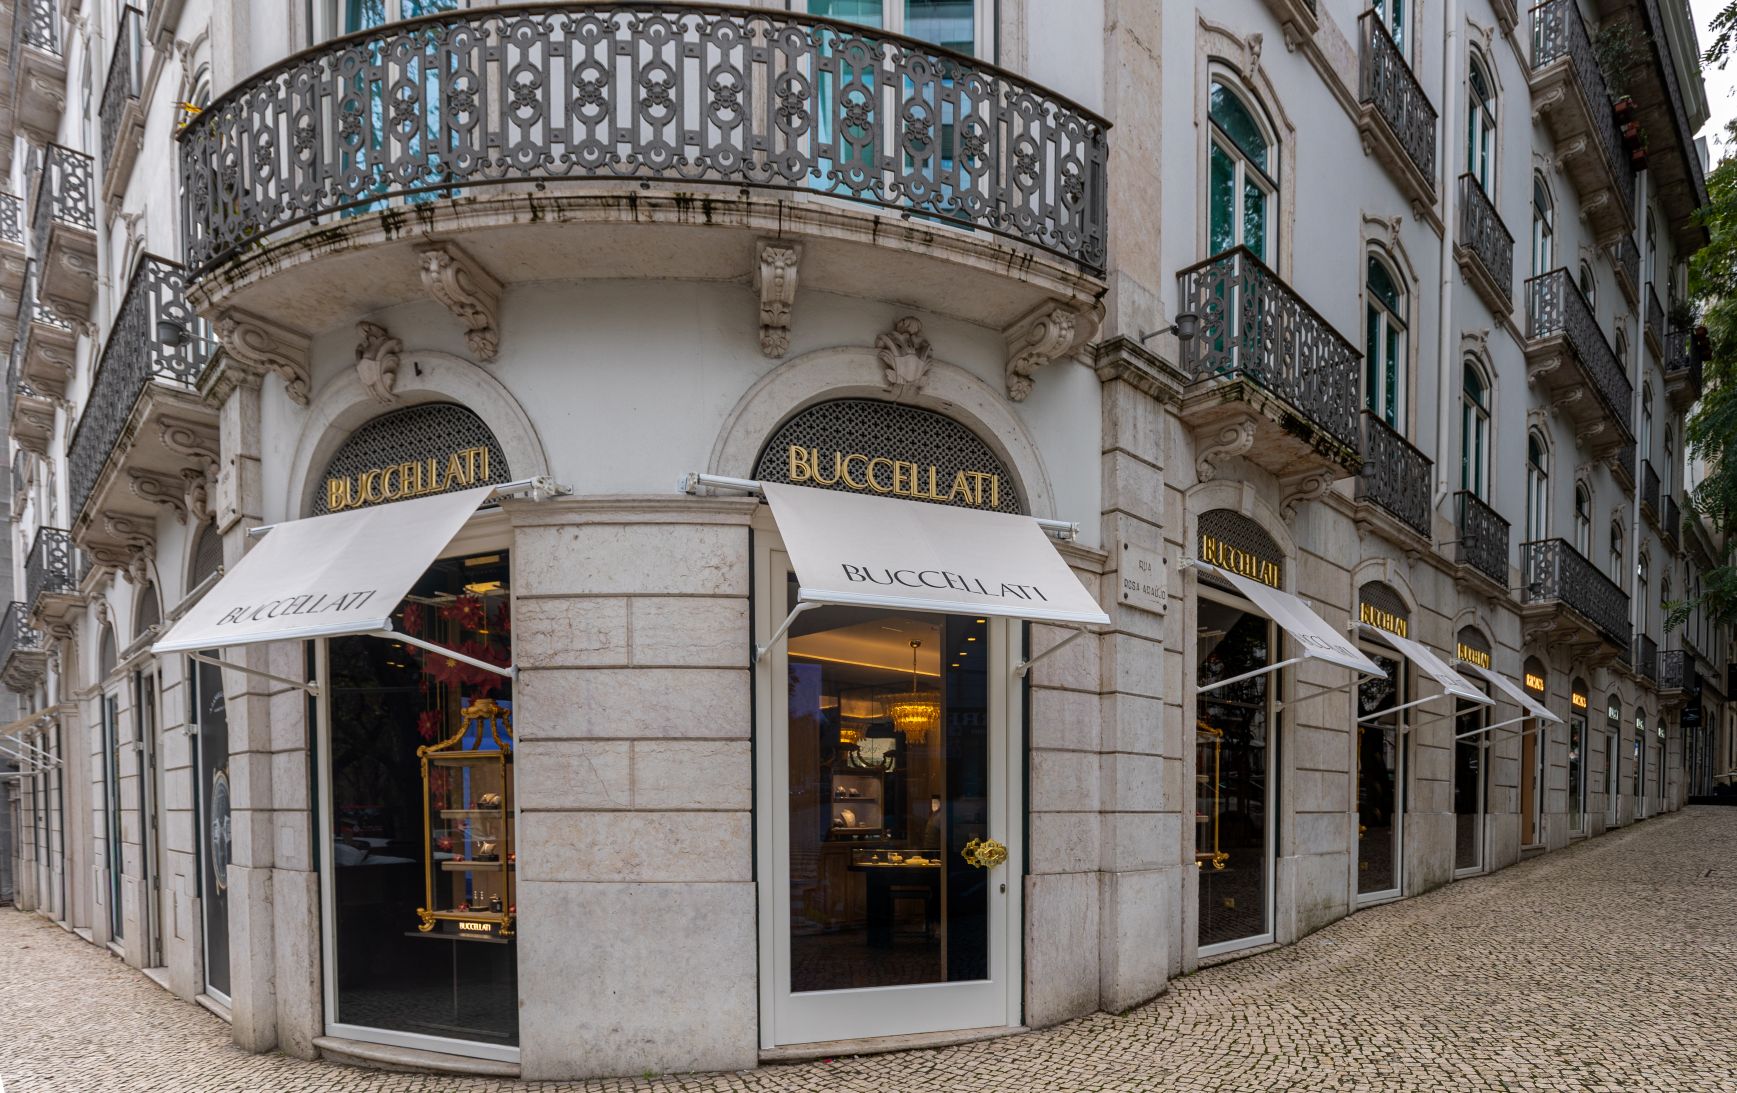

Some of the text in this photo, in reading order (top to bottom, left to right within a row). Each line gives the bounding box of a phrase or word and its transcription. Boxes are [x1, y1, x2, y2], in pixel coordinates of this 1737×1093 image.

[328, 446, 489, 511] BUCCELLATI
[788, 445, 1000, 507] BUCCELLATI
[841, 563, 1048, 601] BUCCELLATI
[1138, 560, 1152, 572] RUA
[1124, 579, 1140, 591] ROSA
[216, 590, 377, 626] BUCCELLATI
[459, 922, 491, 931] BUCCELLATI
